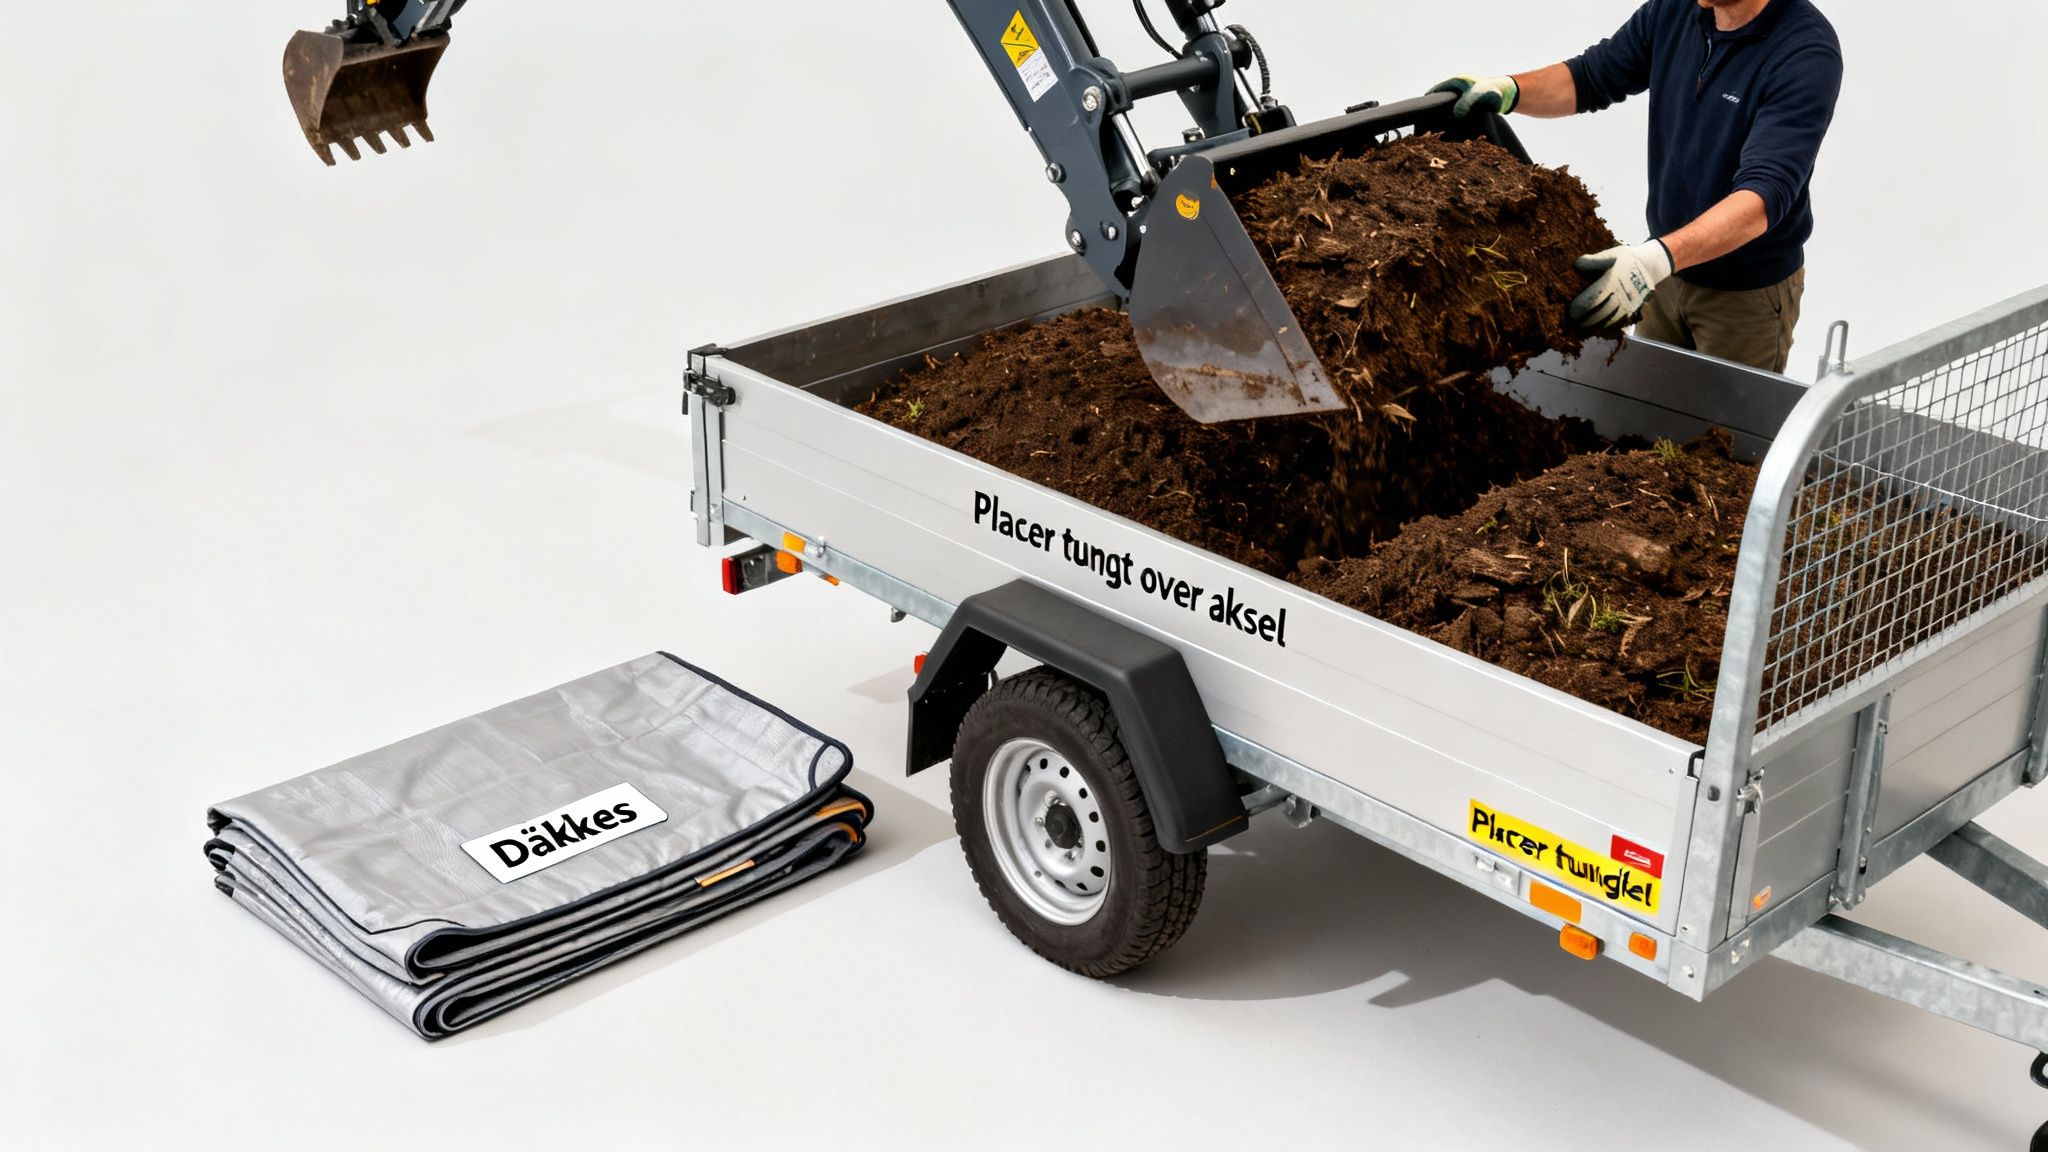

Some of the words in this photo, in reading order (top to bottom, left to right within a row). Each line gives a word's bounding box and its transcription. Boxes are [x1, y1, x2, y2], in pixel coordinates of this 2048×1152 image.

[974, 490, 1055, 552] Placer
[1063, 528, 1133, 589] tungt
[1140, 567, 1204, 611] over
[1209, 587, 1287, 647] aksel
[489, 803, 637, 868] Däkkes
